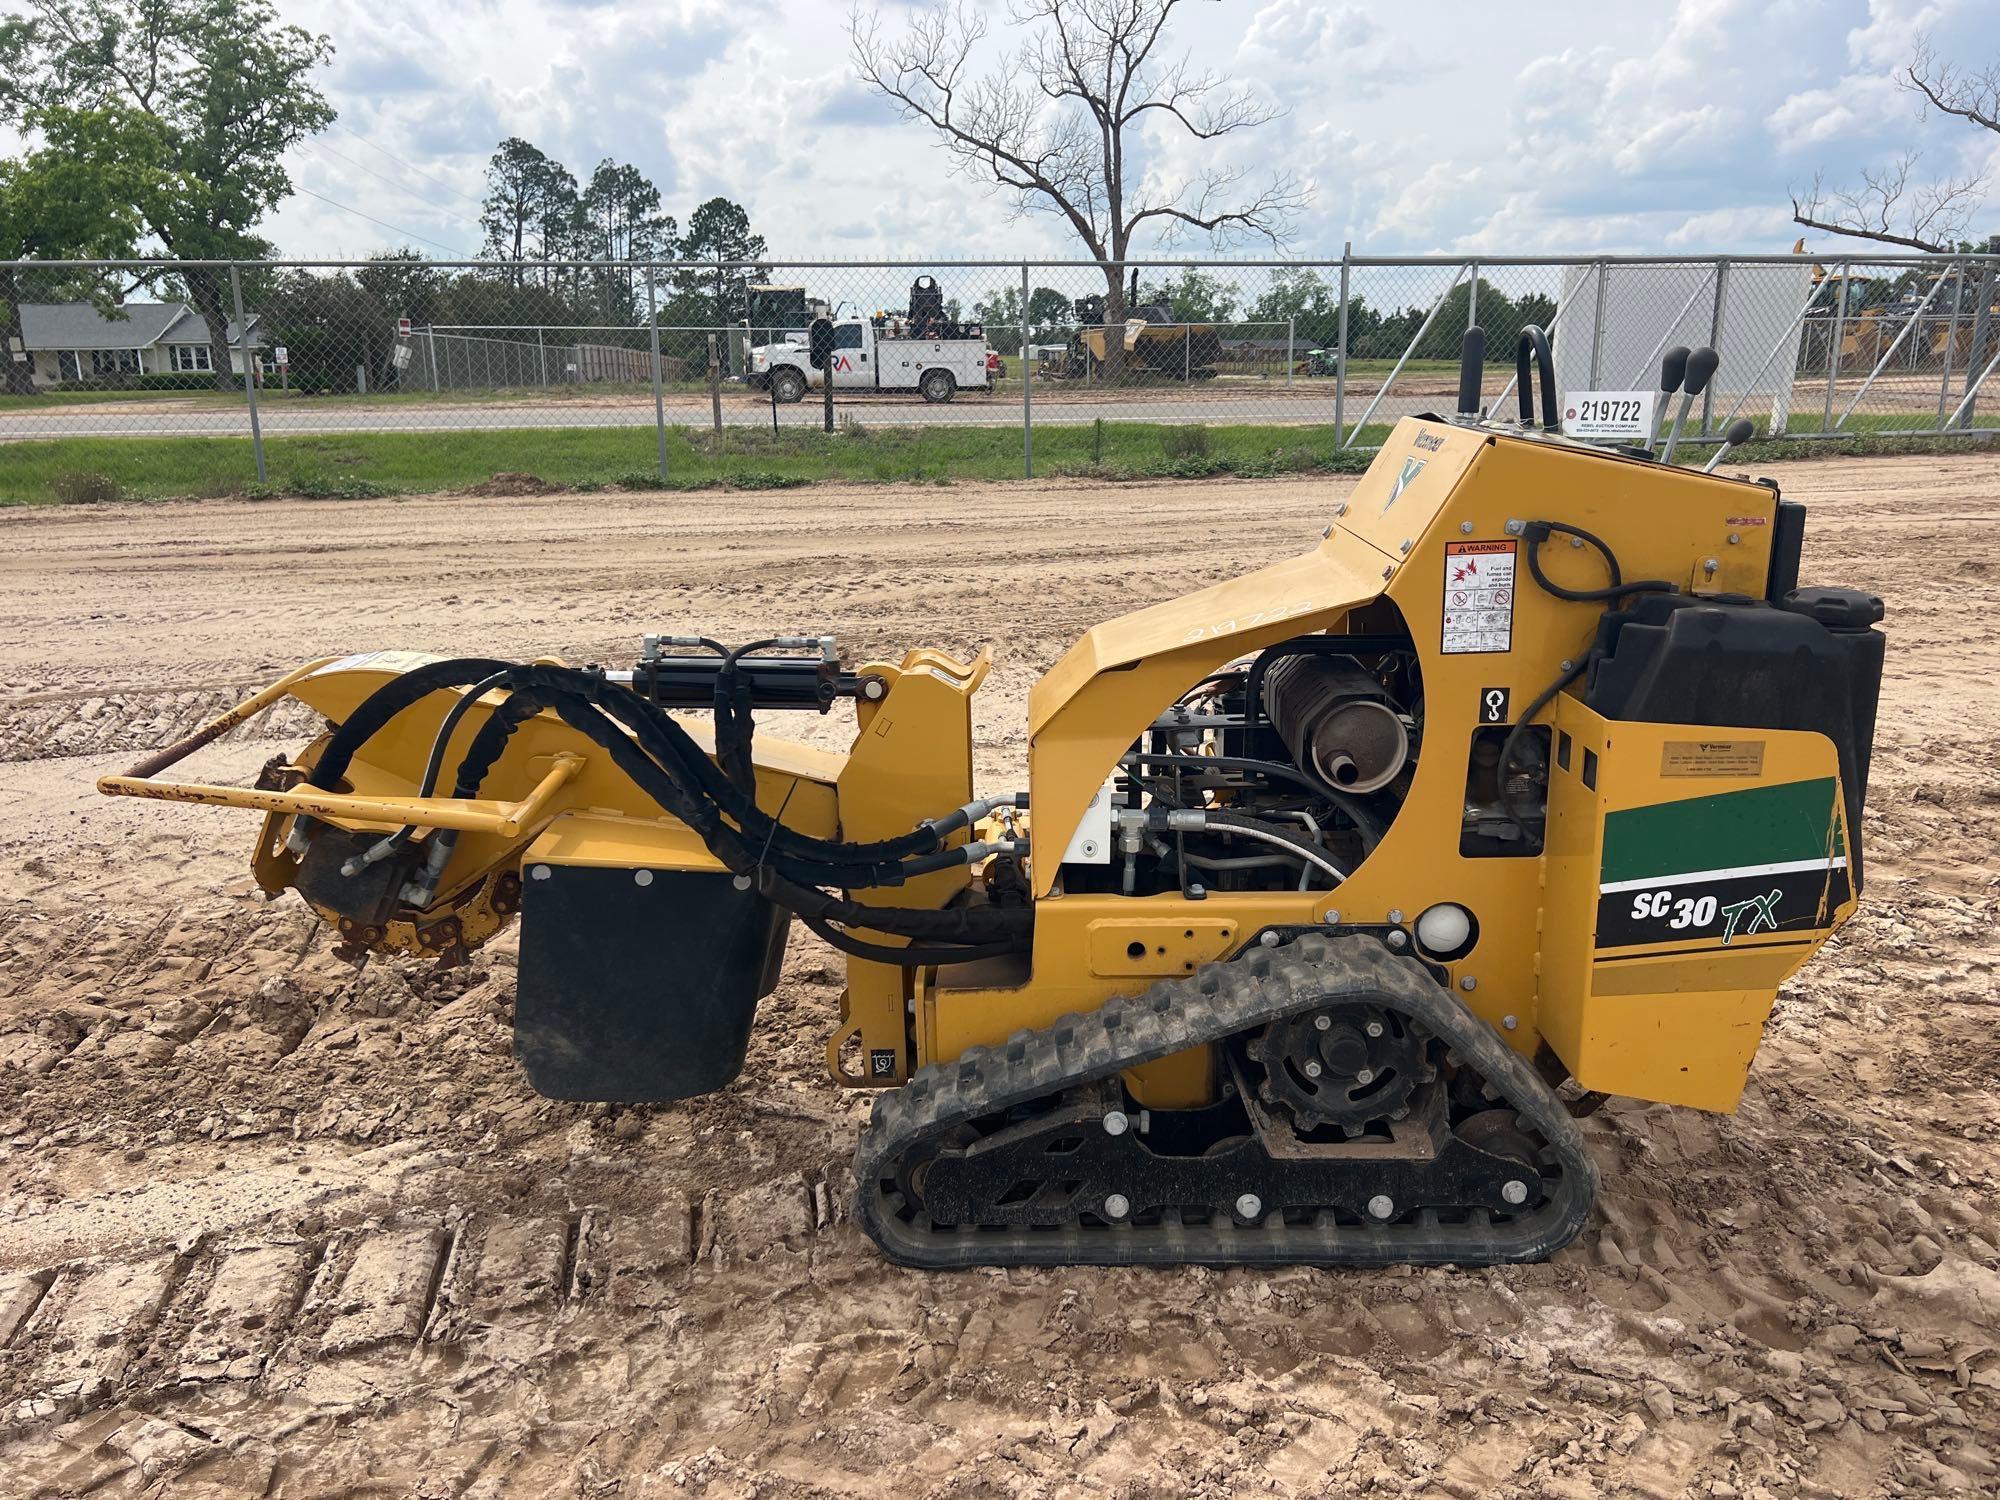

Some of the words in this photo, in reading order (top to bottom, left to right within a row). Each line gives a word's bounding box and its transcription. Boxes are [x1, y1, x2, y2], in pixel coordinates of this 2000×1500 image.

[1580, 400, 1641, 421] 219722
[1467, 543, 1507, 552] WARNING
[1183, 601, 1313, 642] 219722
